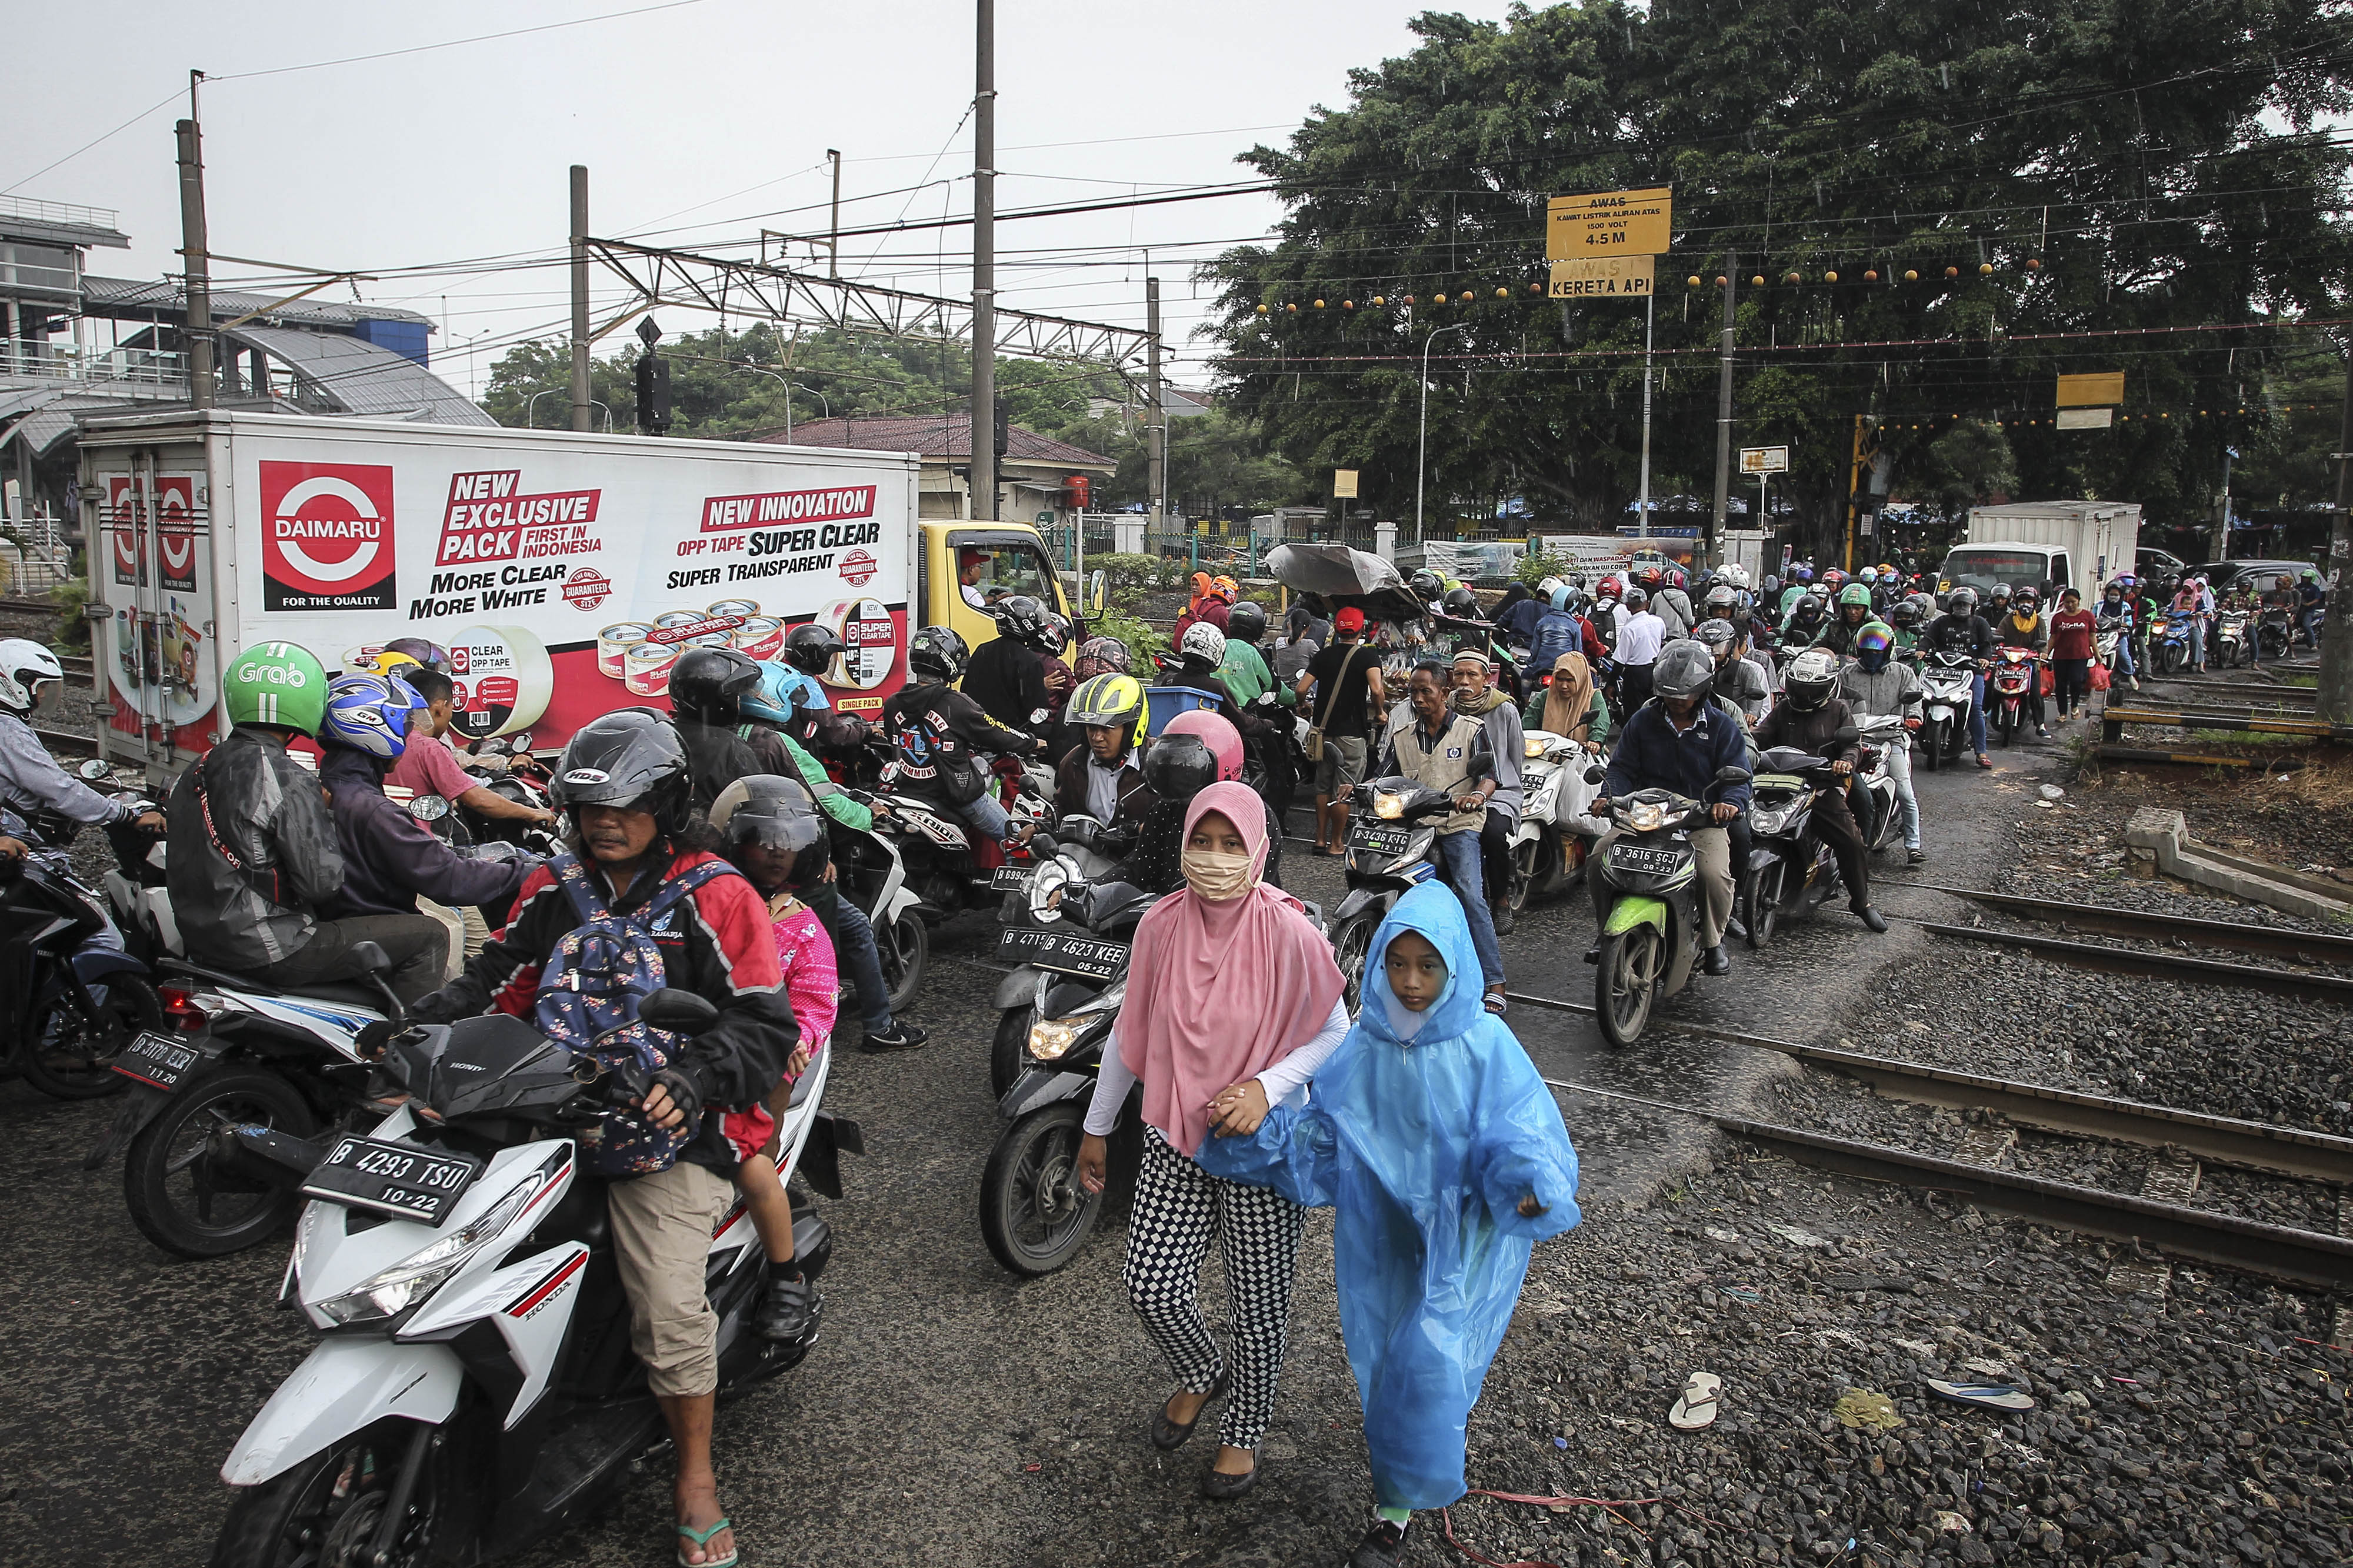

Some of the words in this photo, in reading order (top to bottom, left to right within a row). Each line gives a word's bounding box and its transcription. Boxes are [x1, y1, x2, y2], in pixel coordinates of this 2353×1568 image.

[1589, 197, 1626, 208] AWAS
[1612, 232, 1625, 243] M
[1553, 279, 1615, 295] KERETA
[1624, 278, 1649, 292] API
[454, 473, 516, 501] NEW
[448, 496, 591, 531] EXCLUSIVE
[708, 499, 755, 526] NEW
[758, 489, 868, 522] INNOVATION
[275, 519, 380, 538] DAIMARU
[525, 527, 569, 543] FIRST
[571, 525, 587, 539] IN
[442, 531, 516, 561] PACK
[676, 540, 706, 556] OPP
[711, 536, 746, 553] TAPE
[748, 529, 816, 556] SUPER
[819, 522, 881, 548] CLEAR
[522, 538, 602, 559] INDONESIA
[666, 568, 721, 589] SUPER
[728, 553, 835, 582] TRANSPARENT
[842, 562, 874, 575] GUARANTEED
[430, 572, 496, 595] MORE
[501, 564, 566, 586] CLEAR
[574, 572, 584, 581] THE
[566, 582, 607, 597] GUARANTEED
[282, 597, 306, 606] FOR
[309, 597, 331, 606] THE
[334, 596, 380, 606] QUALITY
[409, 598, 476, 620] MORE
[482, 588, 546, 610] WHITE
[580, 599, 596, 608] SIZE
[671, 619, 728, 634] SUPER
[676, 628, 706, 637] CLEAR
[706, 622, 729, 630] TAPE
[861, 623, 891, 632] SUPER
[472, 646, 503, 656] CLEAR
[754, 640, 779, 650] SUPER
[490, 658, 509, 666] TAPE
[846, 650, 854, 660] 48
[238, 662, 306, 688] Grab
[842, 700, 862, 709] SINGLE
[863, 699, 879, 708] PACK
[356, 712, 377, 722] GM
[568, 772, 603, 782] HDS
[1355, 830, 1361, 839] B
[1364, 831, 1387, 841] 3436
[1614, 847, 1621, 856] B
[1626, 849, 1651, 860] 3616
[998, 869, 1004, 880] B
[1006, 932, 1014, 944] B
[1044, 937, 1056, 950] B
[1061, 940, 1094, 957] 4623
[1094, 946, 1123, 963] KEE
[131, 1037, 146, 1053] B
[142, 1040, 168, 1059] 3178
[331, 1144, 354, 1164] B
[355, 1150, 414, 1179] 4293
[416, 1162, 464, 1189] TSU
[525, 1281, 572, 1322] HONDA
